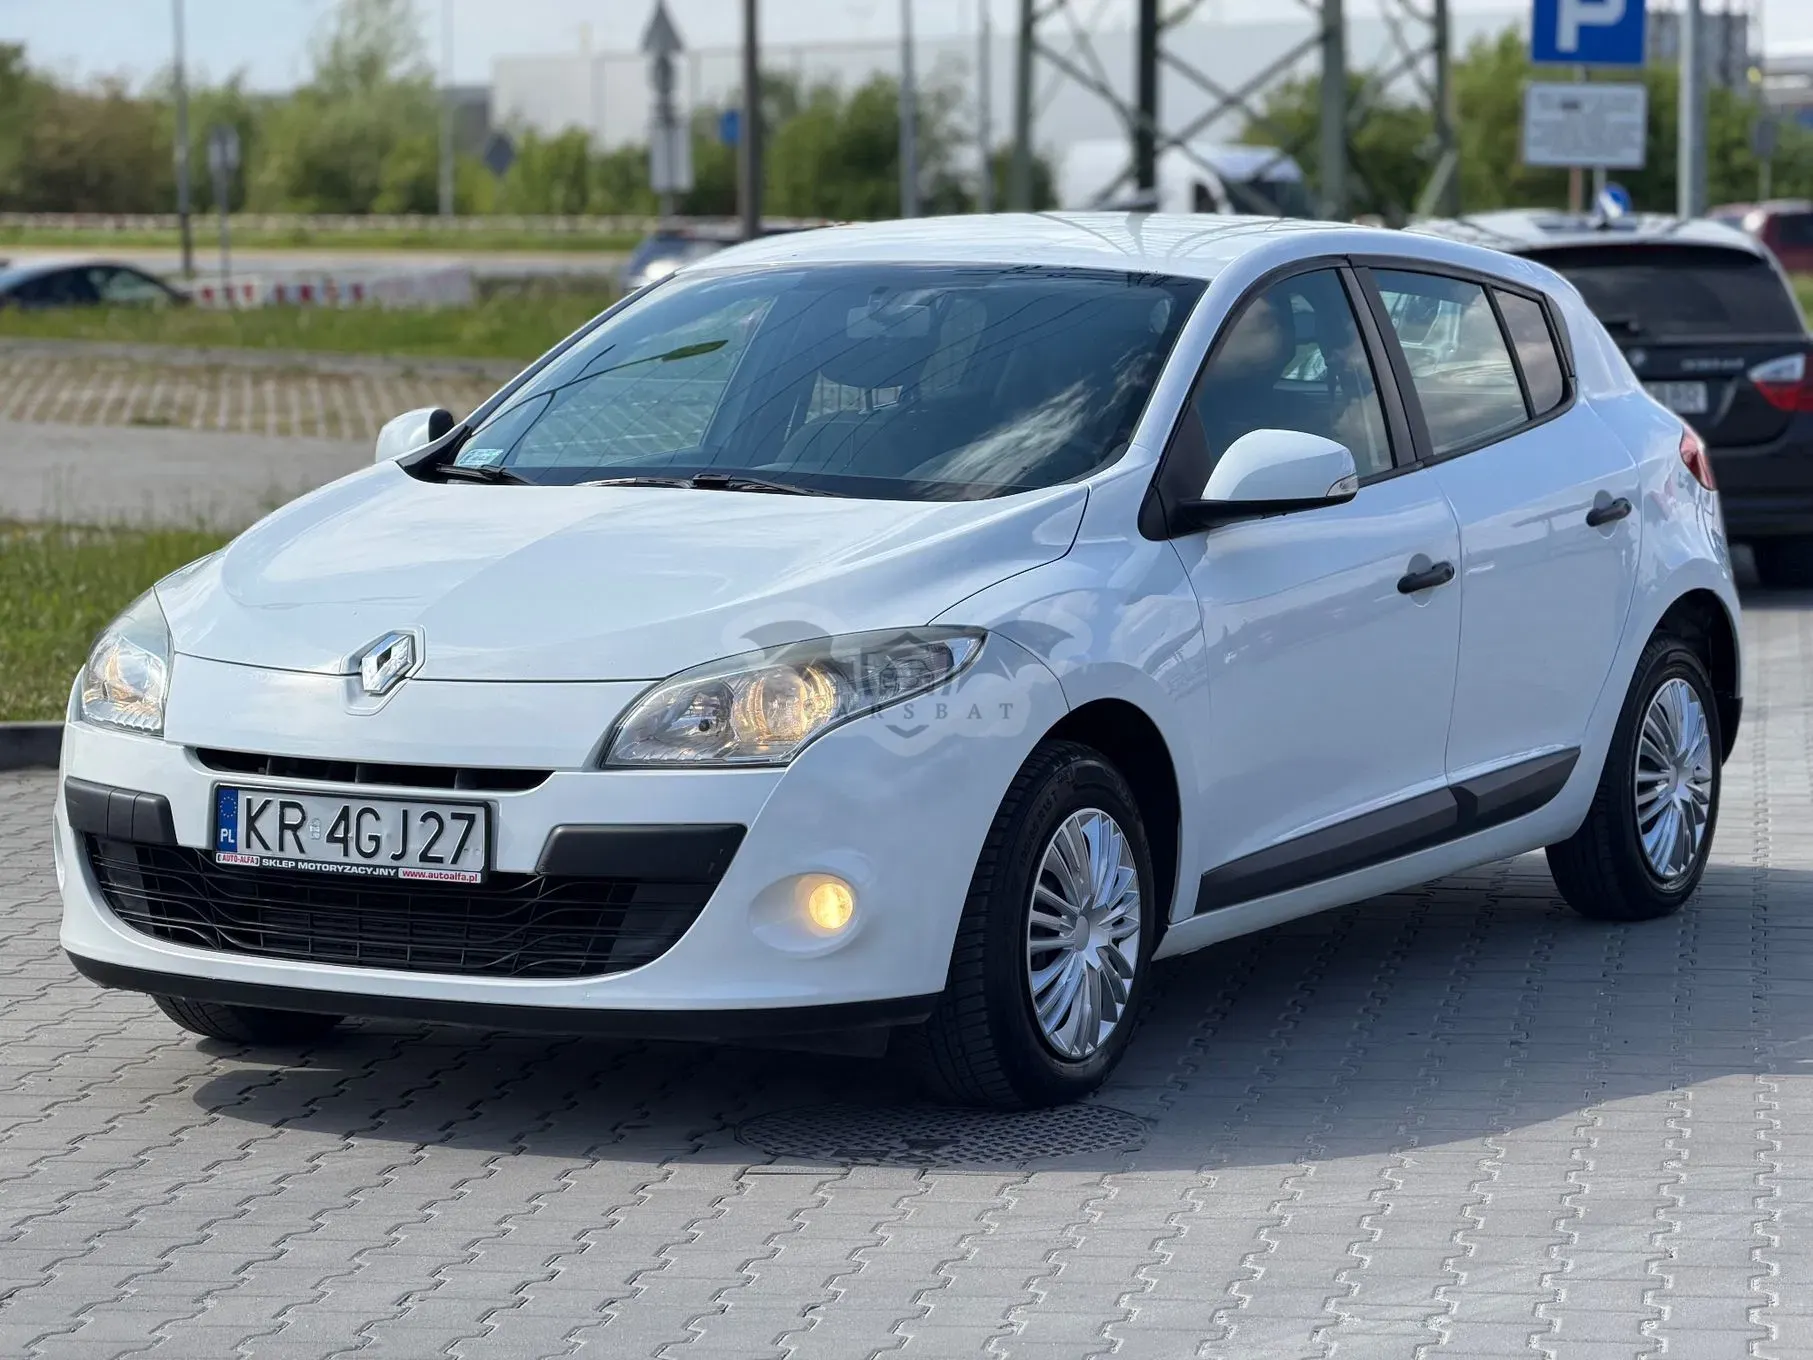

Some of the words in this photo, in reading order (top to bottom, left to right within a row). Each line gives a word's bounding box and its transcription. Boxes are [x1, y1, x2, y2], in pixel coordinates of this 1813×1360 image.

[1556, 0, 1627, 52] P
[220, 828, 235, 843] PL
[245, 796, 306, 854] KR
[325, 805, 477, 865] 4GJ27
[262, 858, 296, 869] SKLEP
[298, 862, 397, 877] MOTORYZACYJNY
[402, 869, 478, 883] www.autoalfa.pl
